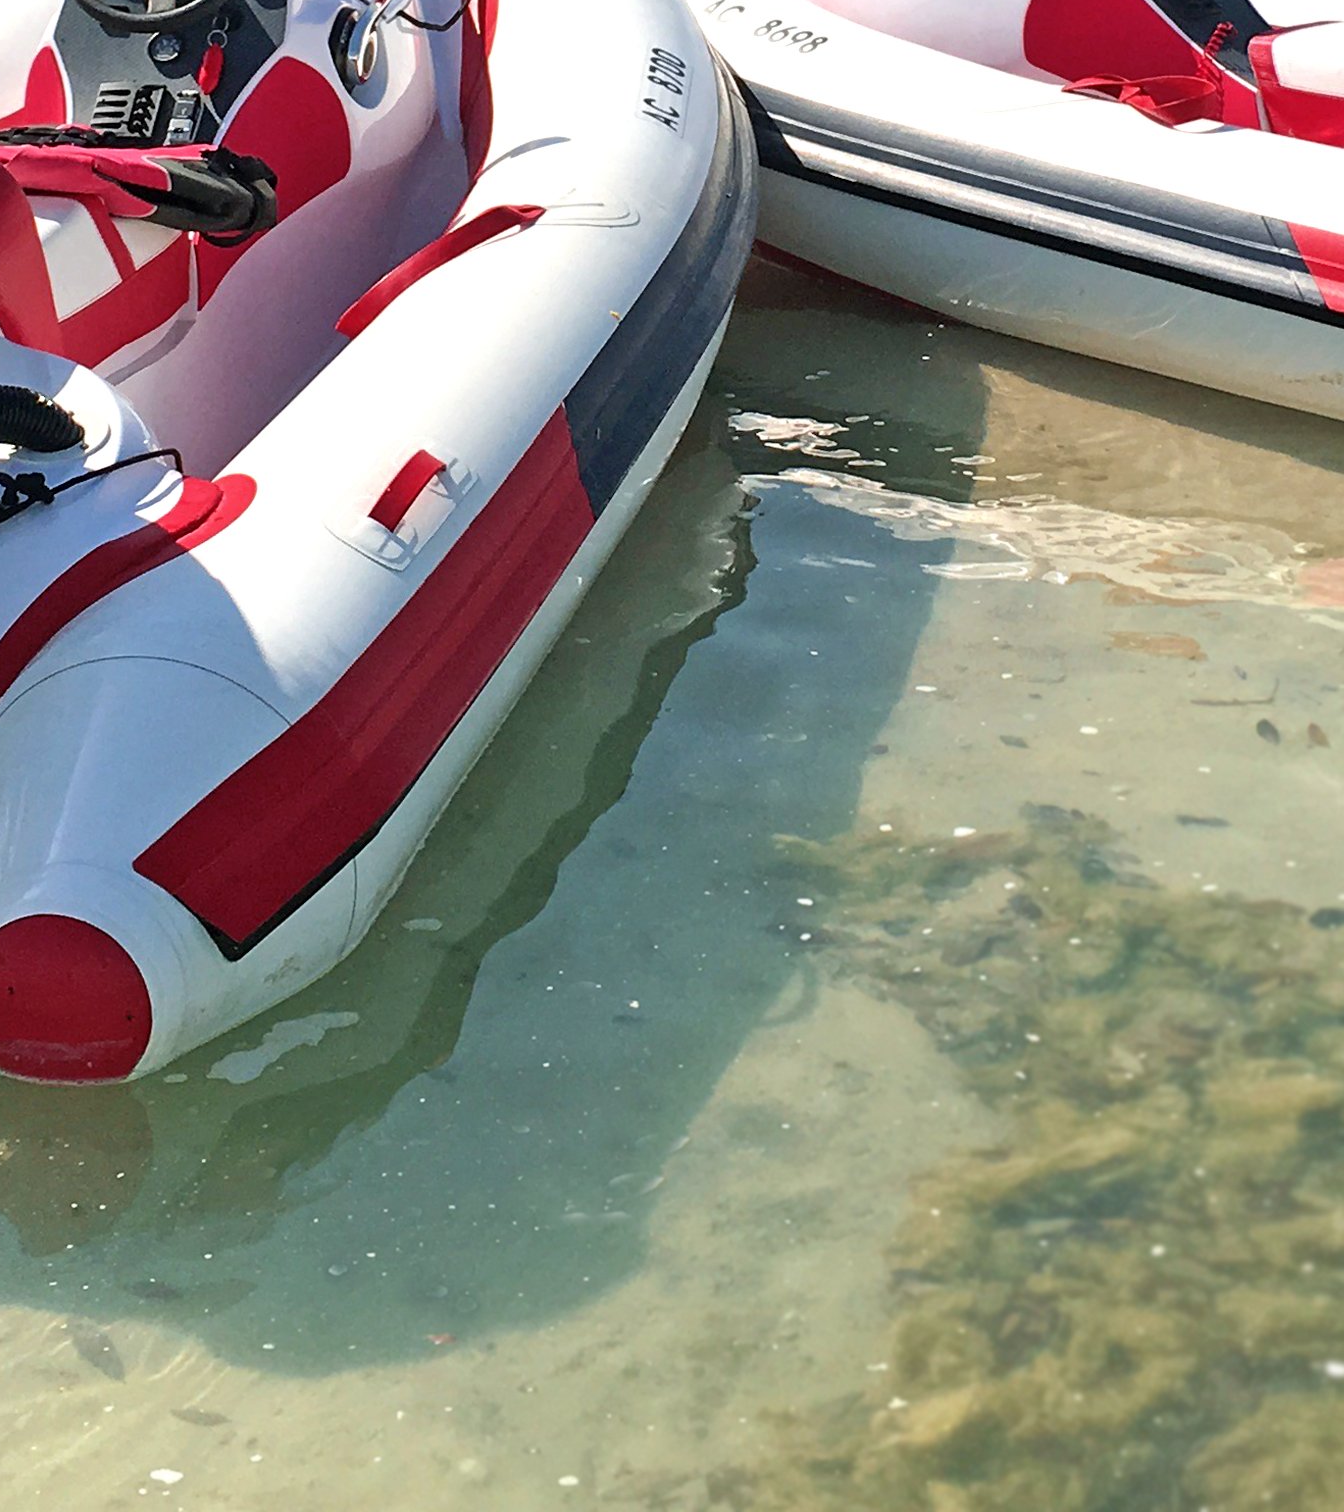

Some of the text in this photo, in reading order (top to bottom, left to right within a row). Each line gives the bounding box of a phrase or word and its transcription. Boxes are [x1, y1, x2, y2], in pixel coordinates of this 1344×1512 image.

[704, 0, 828, 54] AC 8698
[642, 48, 687, 133] AC 8700
